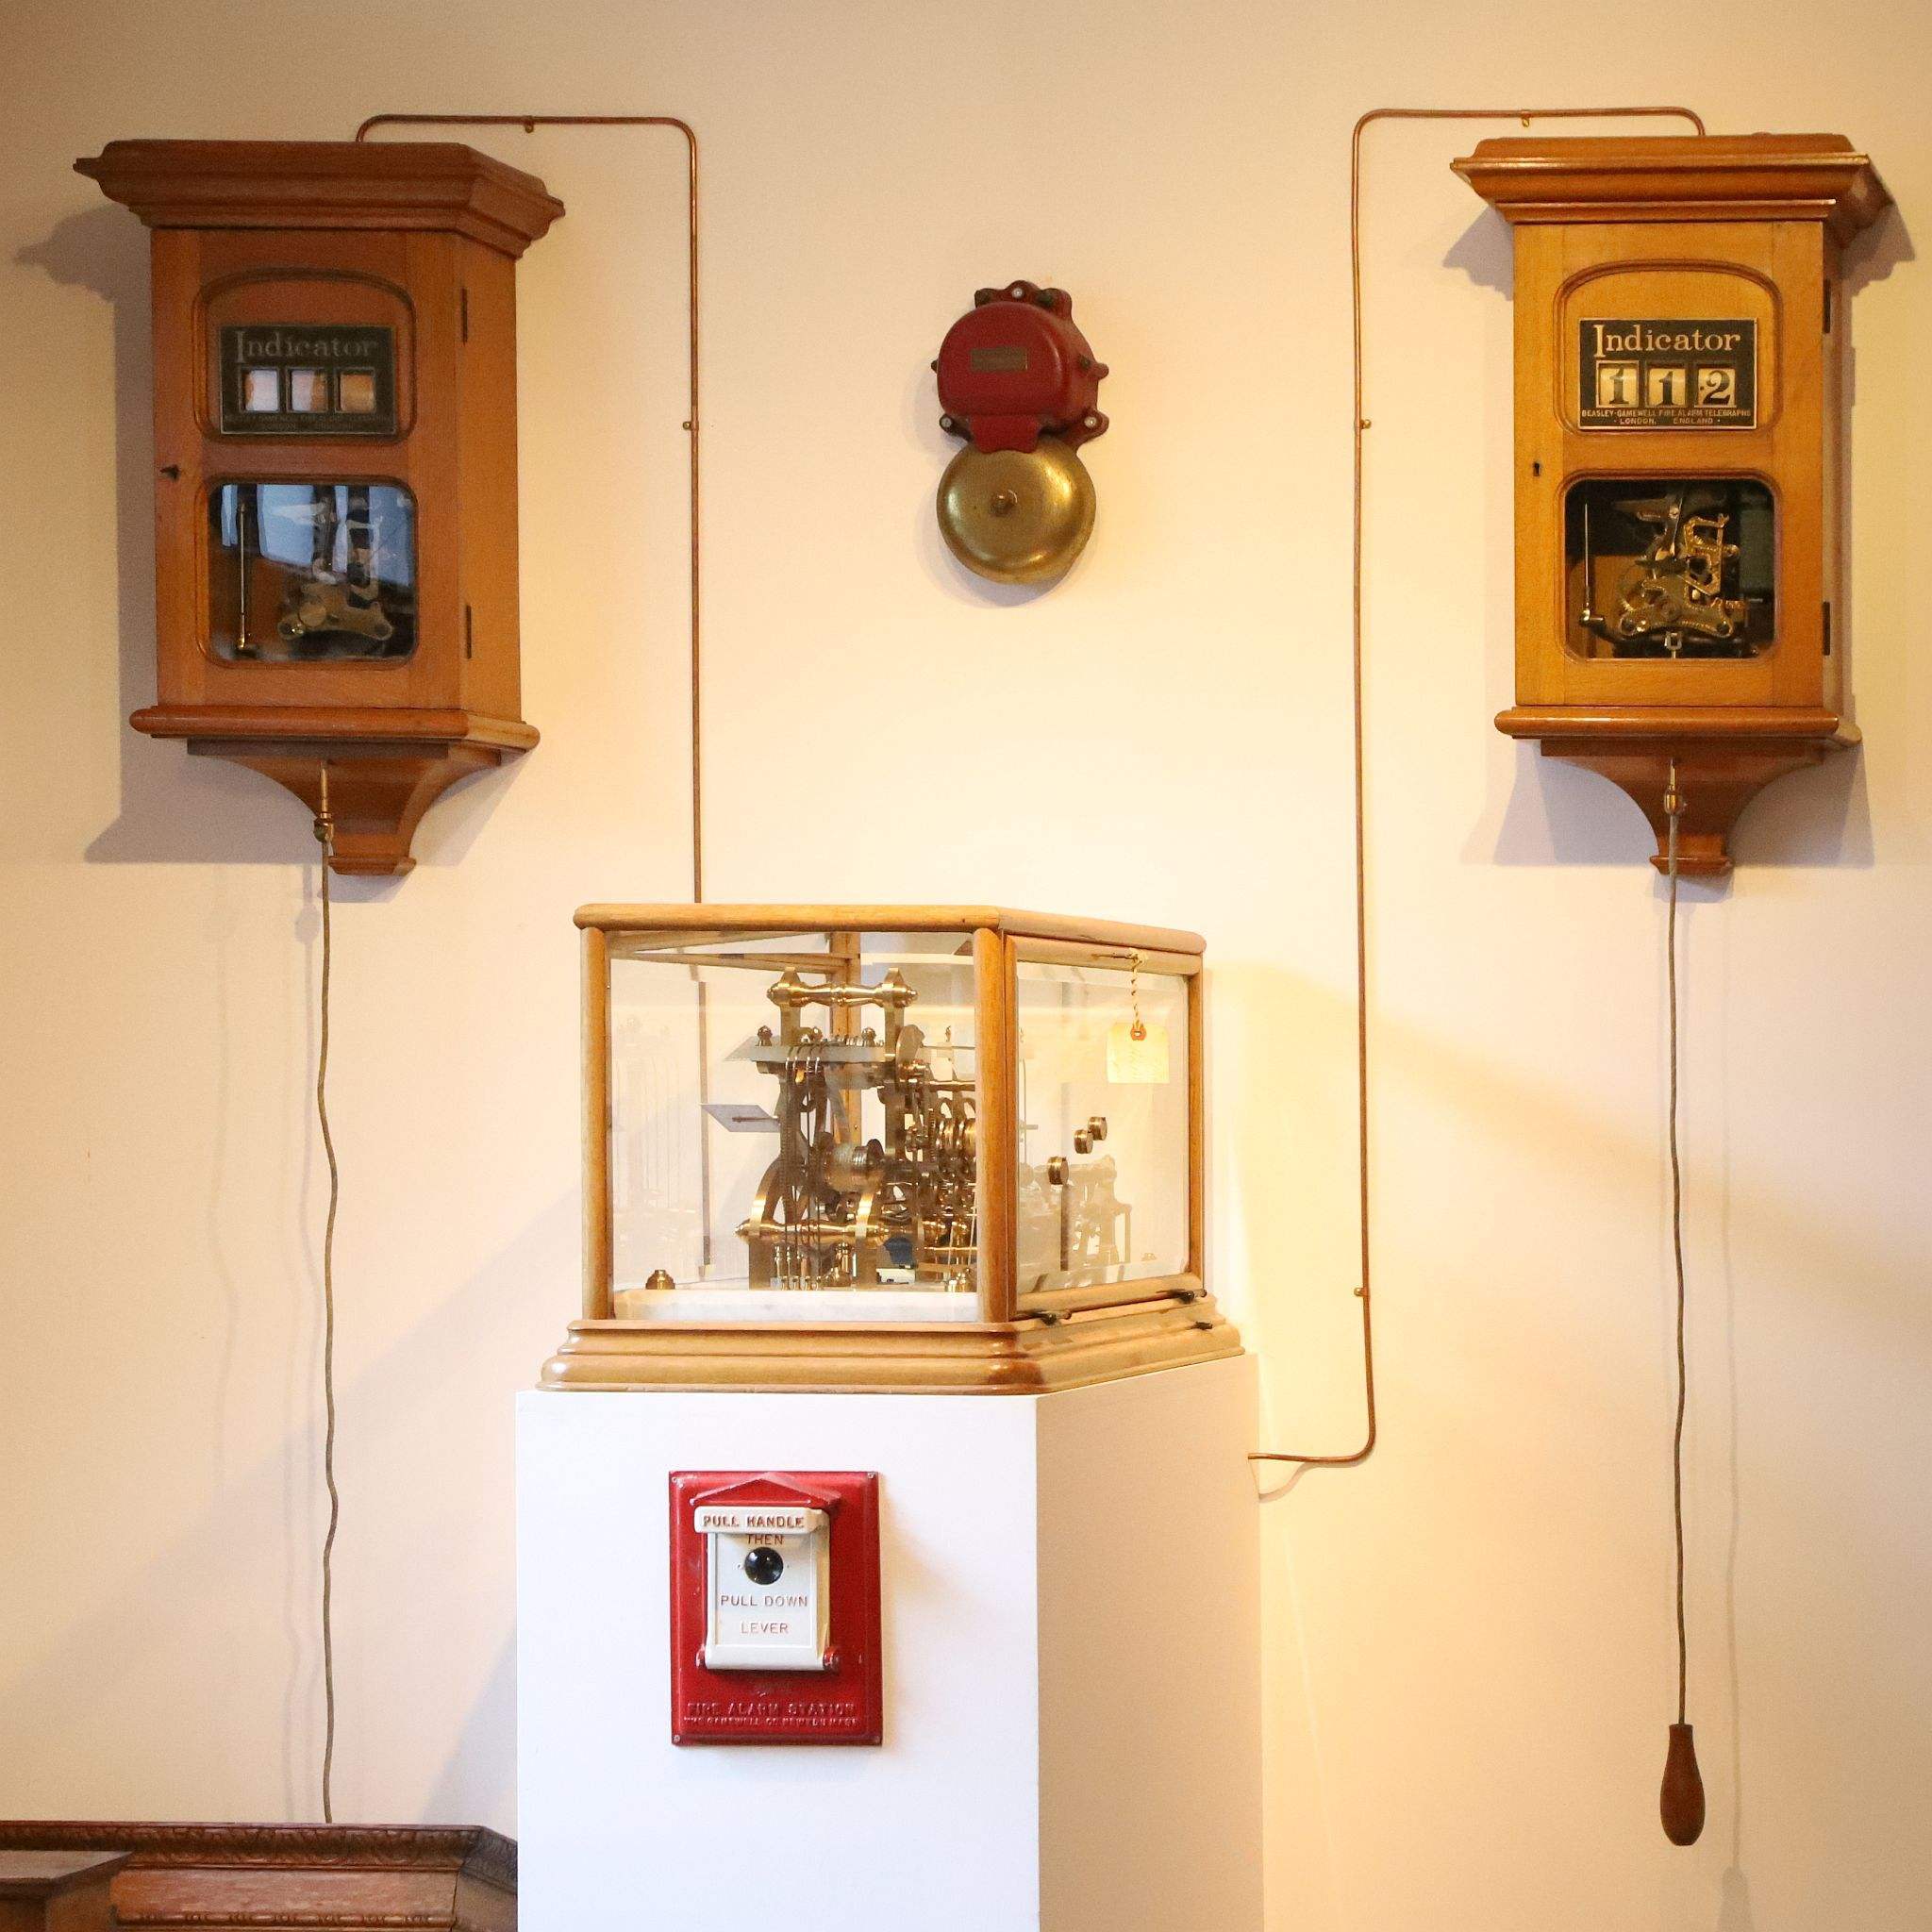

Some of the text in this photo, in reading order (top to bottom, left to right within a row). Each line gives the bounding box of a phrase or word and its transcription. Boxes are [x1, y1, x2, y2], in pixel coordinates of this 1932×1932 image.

[238, 331, 377, 363] Indicator
[1593, 324, 1741, 358] Indicator
[703, 1516, 805, 1528] PULL HANDLE
[748, 1534, 784, 1545] THEN
[720, 1595, 808, 1607] PULL DOWN
[741, 1623, 789, 1634] LEVER
